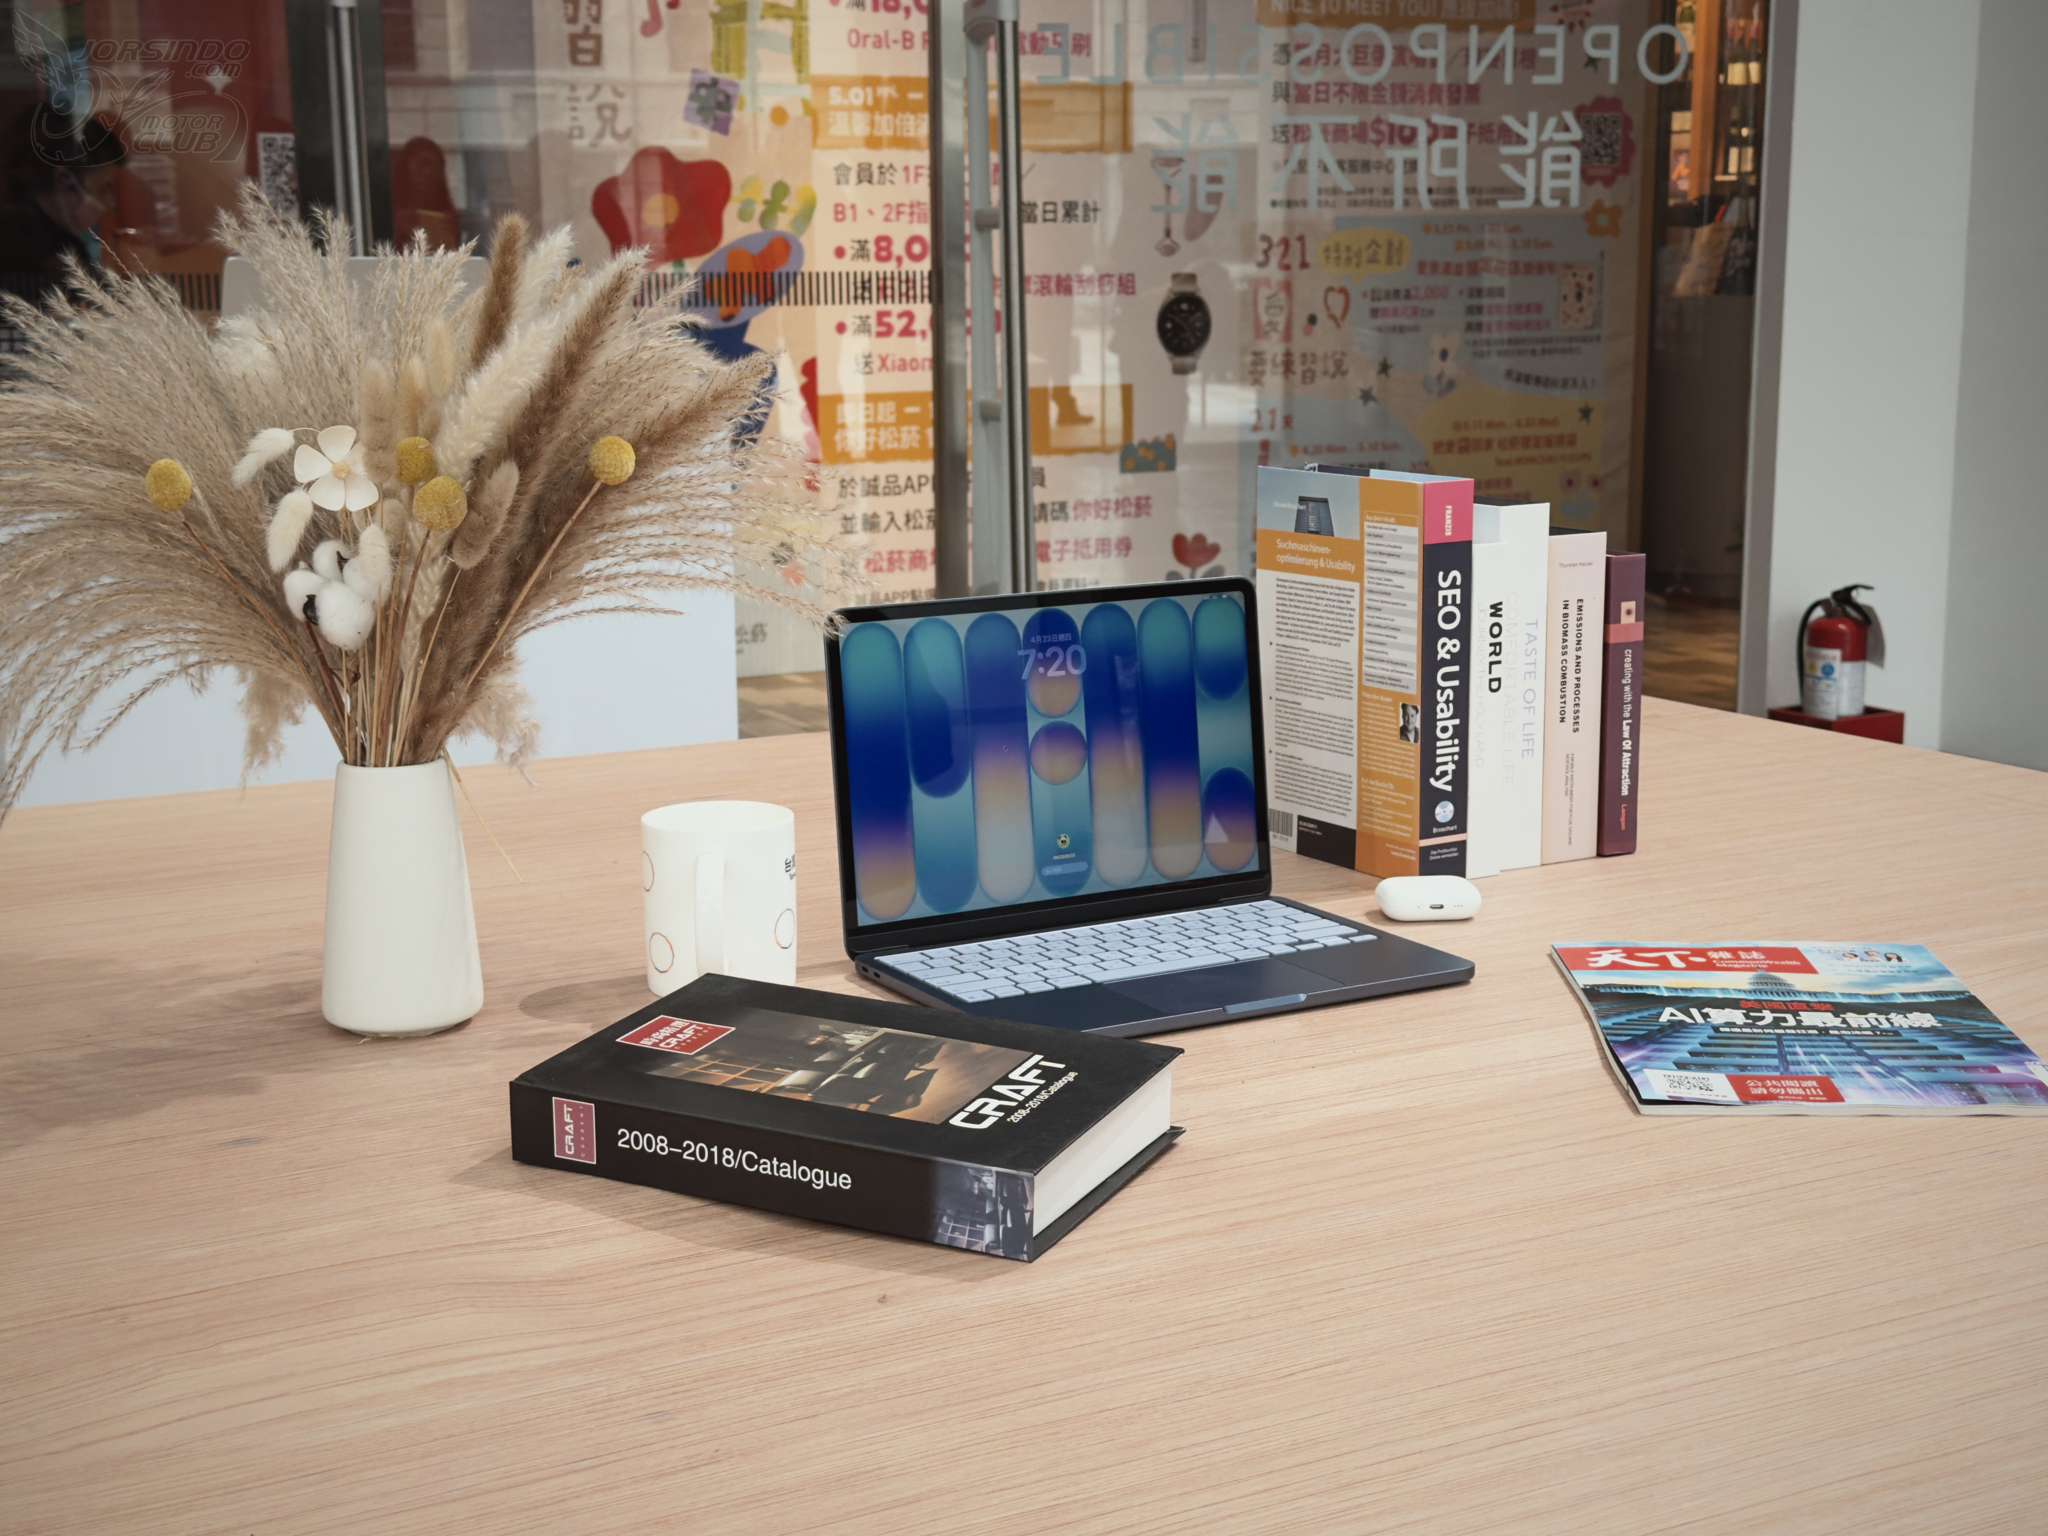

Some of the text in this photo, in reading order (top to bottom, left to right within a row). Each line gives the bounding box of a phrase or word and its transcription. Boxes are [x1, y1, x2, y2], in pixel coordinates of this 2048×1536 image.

[847, 28, 915, 50] Oral-B
[852, 309, 933, 342] 滿52,
[839, 474, 935, 498] 於誠品AP
[1444, 505, 1452, 536] FRANZIS
[1276, 539, 1331, 554] Suchmaschinen-
[1276, 553, 1355, 574] optimierung & Usability
[1017, 645, 1087, 680] 7:20
[1488, 601, 1503, 693] WORLD
[1559, 599, 1570, 724] IN BIOMASS COMBUSTION
[1429, 569, 1462, 792] SEO & Usability
[1572, 598, 1584, 734] EMISSIONS AND PROCESSES
[1521, 618, 1539, 760] TASTE OF LIFE
[1620, 649, 1633, 796] creating with the Law Of Attraction
[1501, 749, 1516, 788] LIFE
[1586, 949, 1767, 968] 天下 雜誌
[1658, 1007, 1943, 1029] AI算力最前線
[659, 1024, 704, 1048] CRAFT
[949, 1054, 1066, 1129] CRAFT
[564, 1103, 575, 1155] CRAFT
